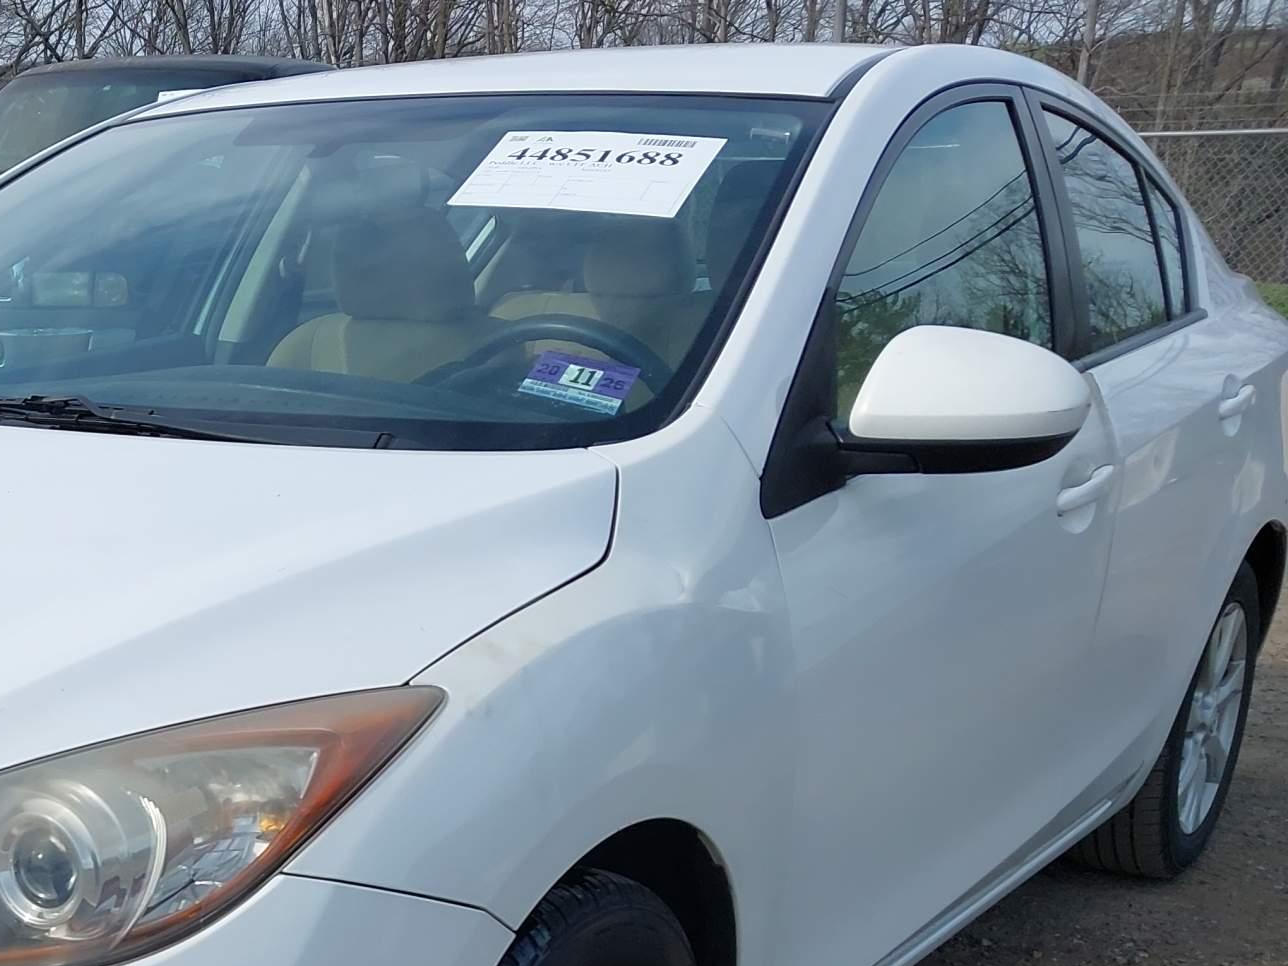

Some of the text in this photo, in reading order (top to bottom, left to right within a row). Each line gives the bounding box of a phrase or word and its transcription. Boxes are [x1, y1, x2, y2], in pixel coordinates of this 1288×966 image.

[507, 147, 683, 167] 44851688
[536, 363, 626, 390] 20 11 26
